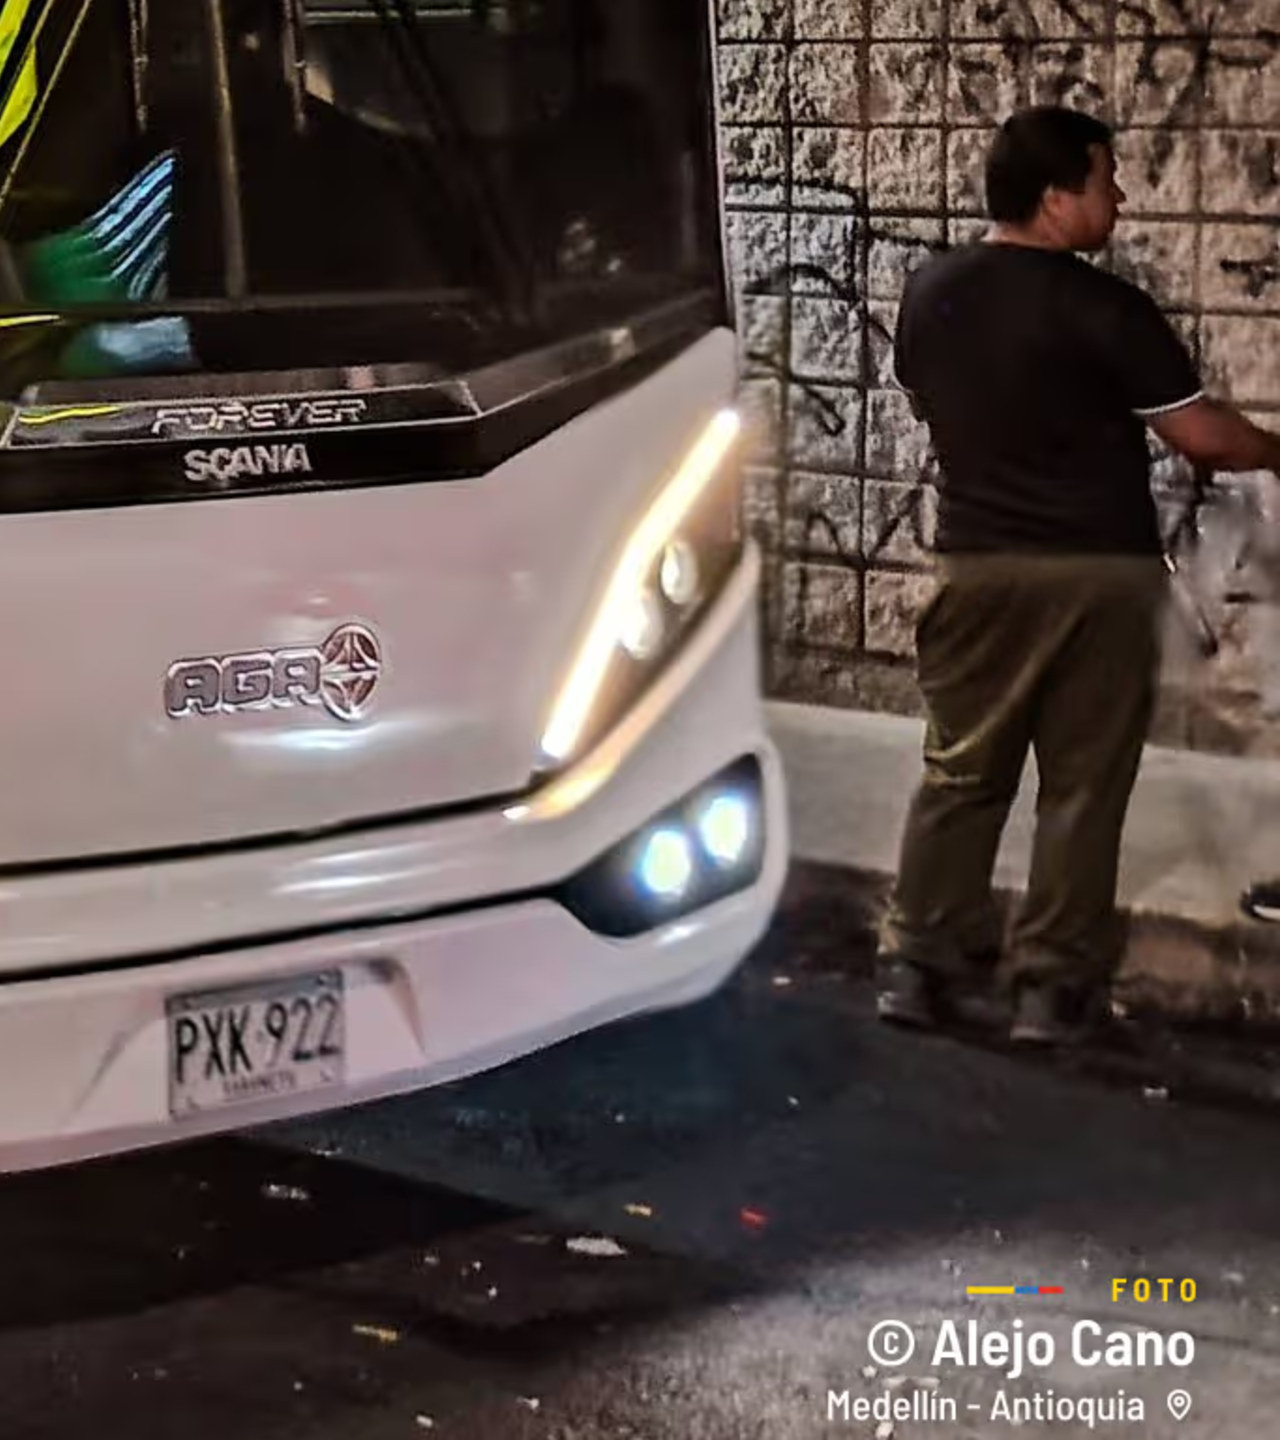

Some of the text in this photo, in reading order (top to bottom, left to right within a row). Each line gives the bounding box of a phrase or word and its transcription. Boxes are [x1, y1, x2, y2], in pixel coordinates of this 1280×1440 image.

[151, 398, 367, 435] FOREVER
[183, 442, 312, 483] SCANIA
[164, 647, 324, 719] AGA
